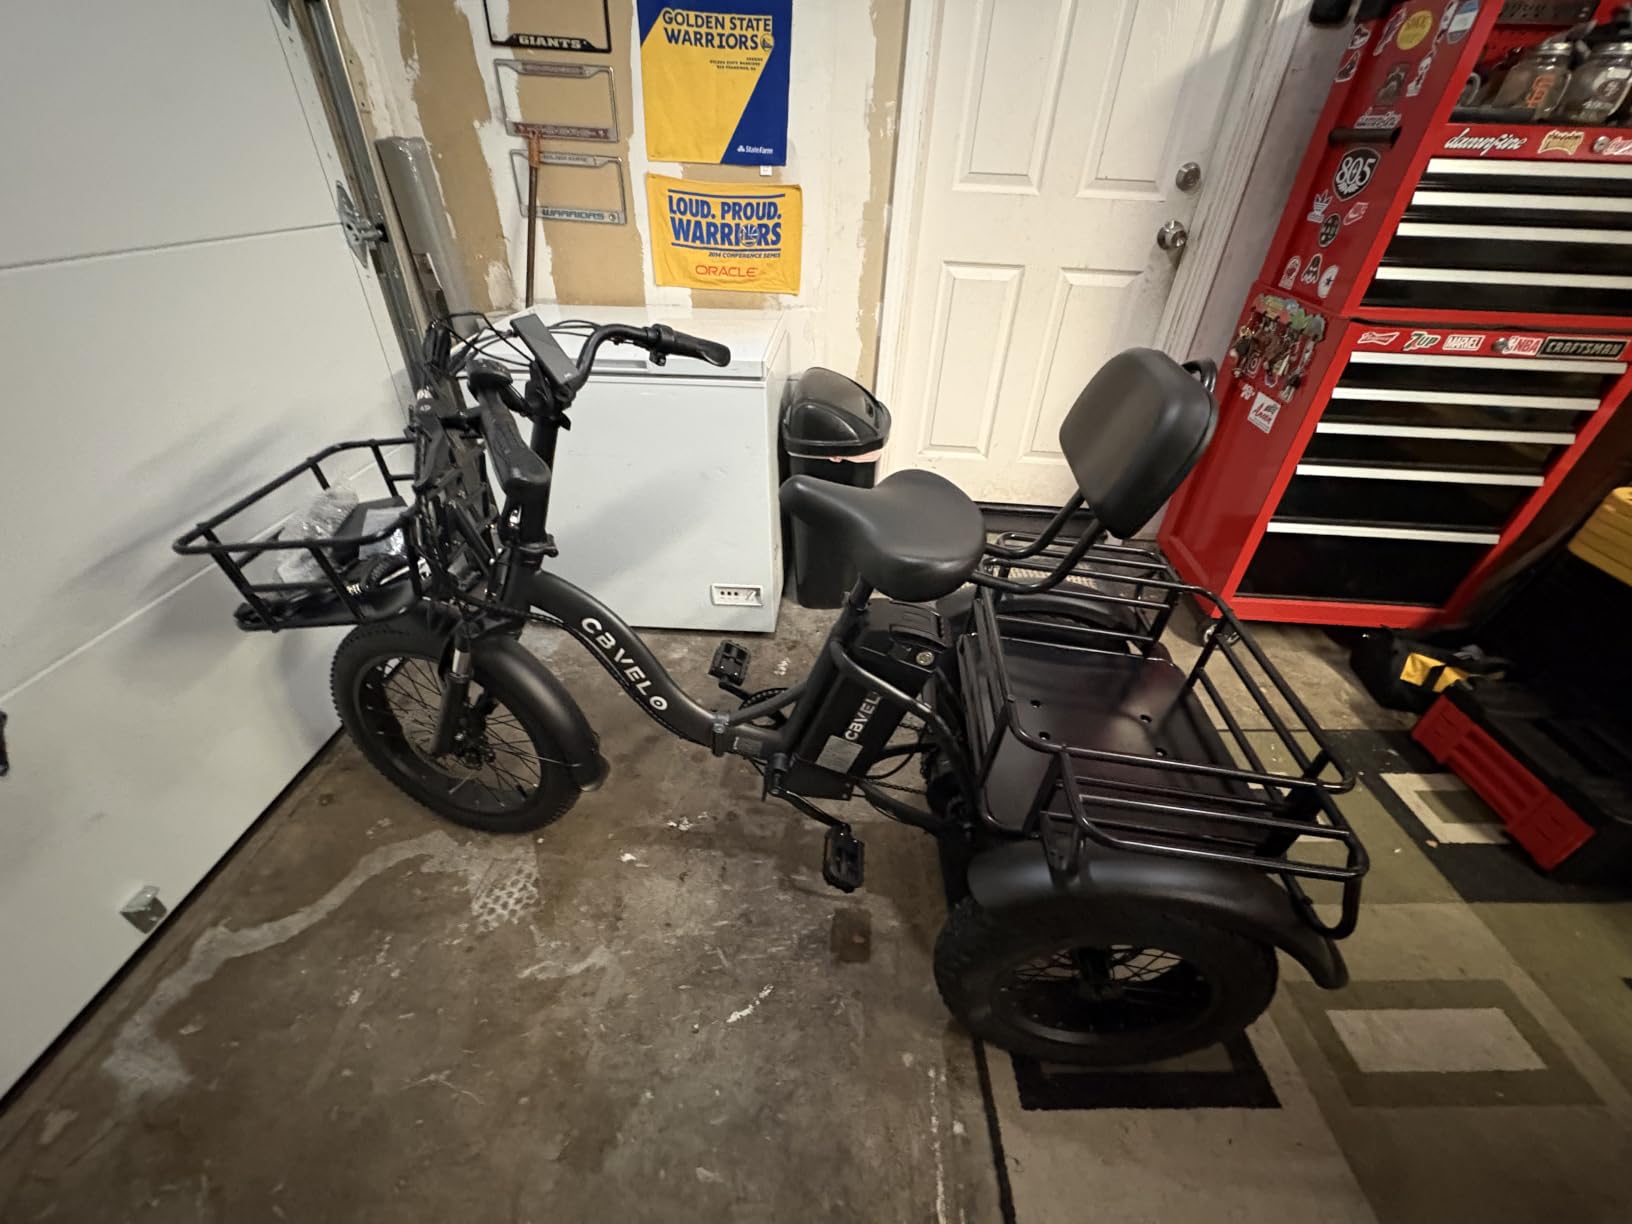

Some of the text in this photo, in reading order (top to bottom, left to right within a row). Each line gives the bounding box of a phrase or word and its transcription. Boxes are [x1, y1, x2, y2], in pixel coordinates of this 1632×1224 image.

[662, 10, 772, 32] GOLDEN STATE
[518, 35, 581, 49] GIANTS
[663, 27, 759, 50] WARRIORS
[1335, 156, 1376, 187] 805
[668, 195, 782, 221] LOUD. PROUD.
[695, 264, 759, 278] ORACLE
[1404, 332, 1440, 350] 7UP
[1515, 337, 1542, 353] NBA
[1546, 341, 1623, 355] CRAFTSMAN
[581, 617, 668, 711] CBVELO
[844, 691, 883, 741] CBVEL
